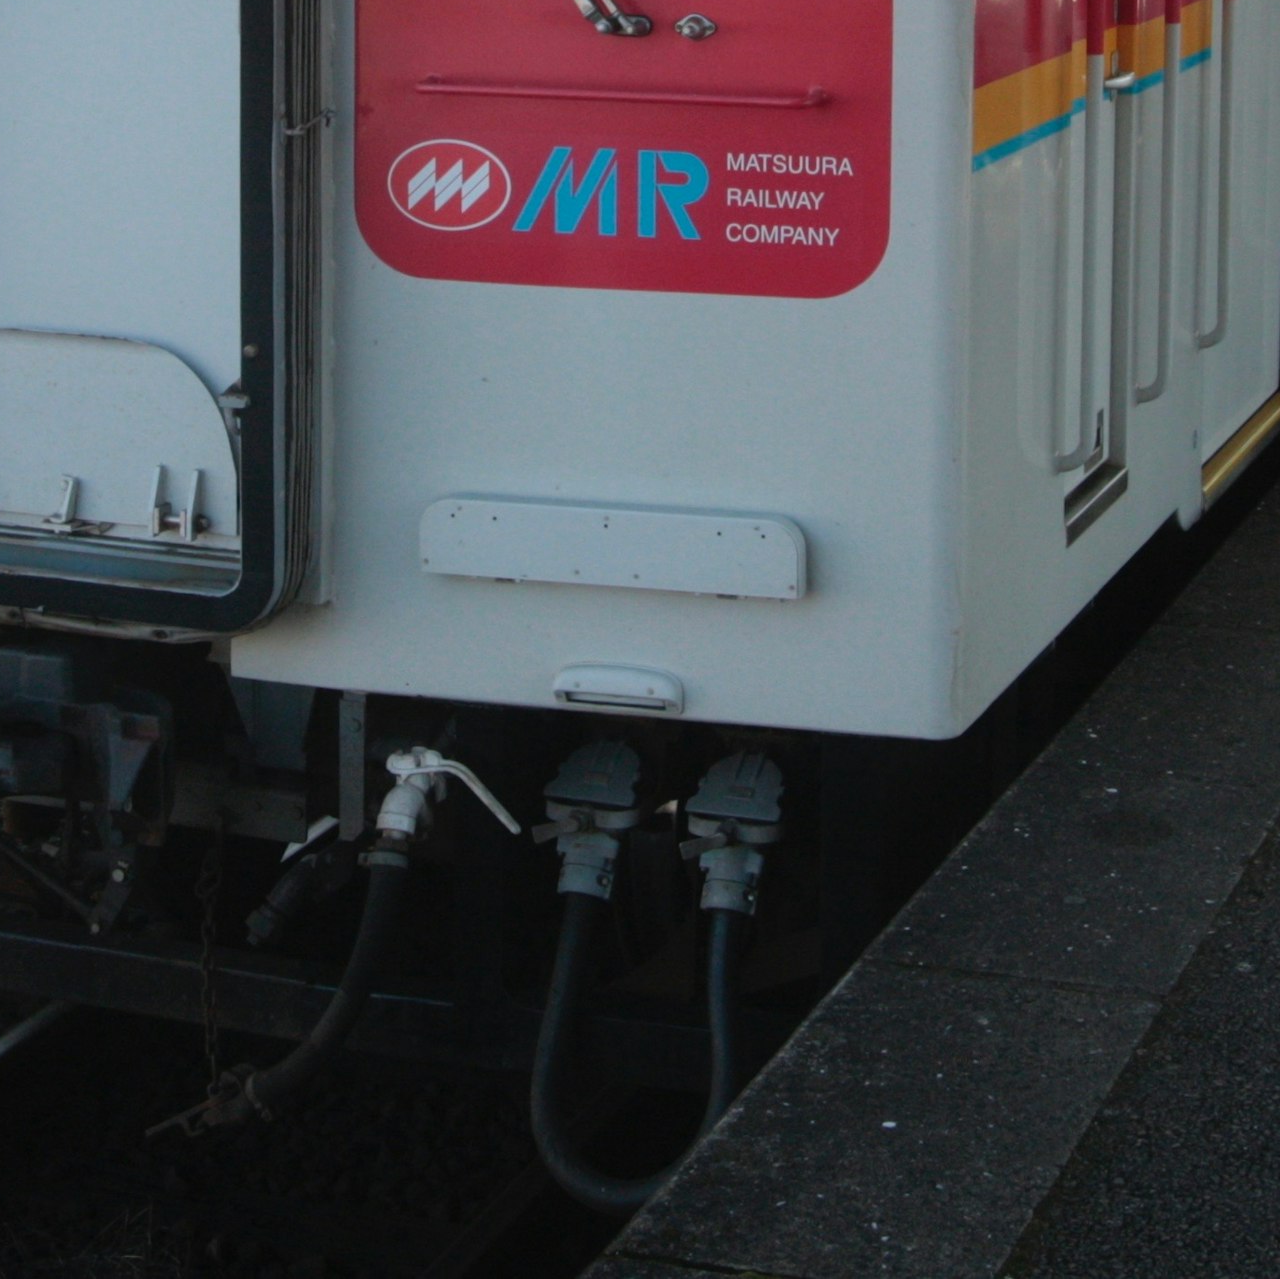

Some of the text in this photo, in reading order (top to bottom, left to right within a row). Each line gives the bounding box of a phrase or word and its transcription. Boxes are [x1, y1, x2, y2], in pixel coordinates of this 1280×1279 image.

[726, 152, 853, 177] MATSUURA
[512, 146, 709, 240] MR
[726, 187, 825, 211] RAILWAY
[725, 222, 840, 247] COMPANY
